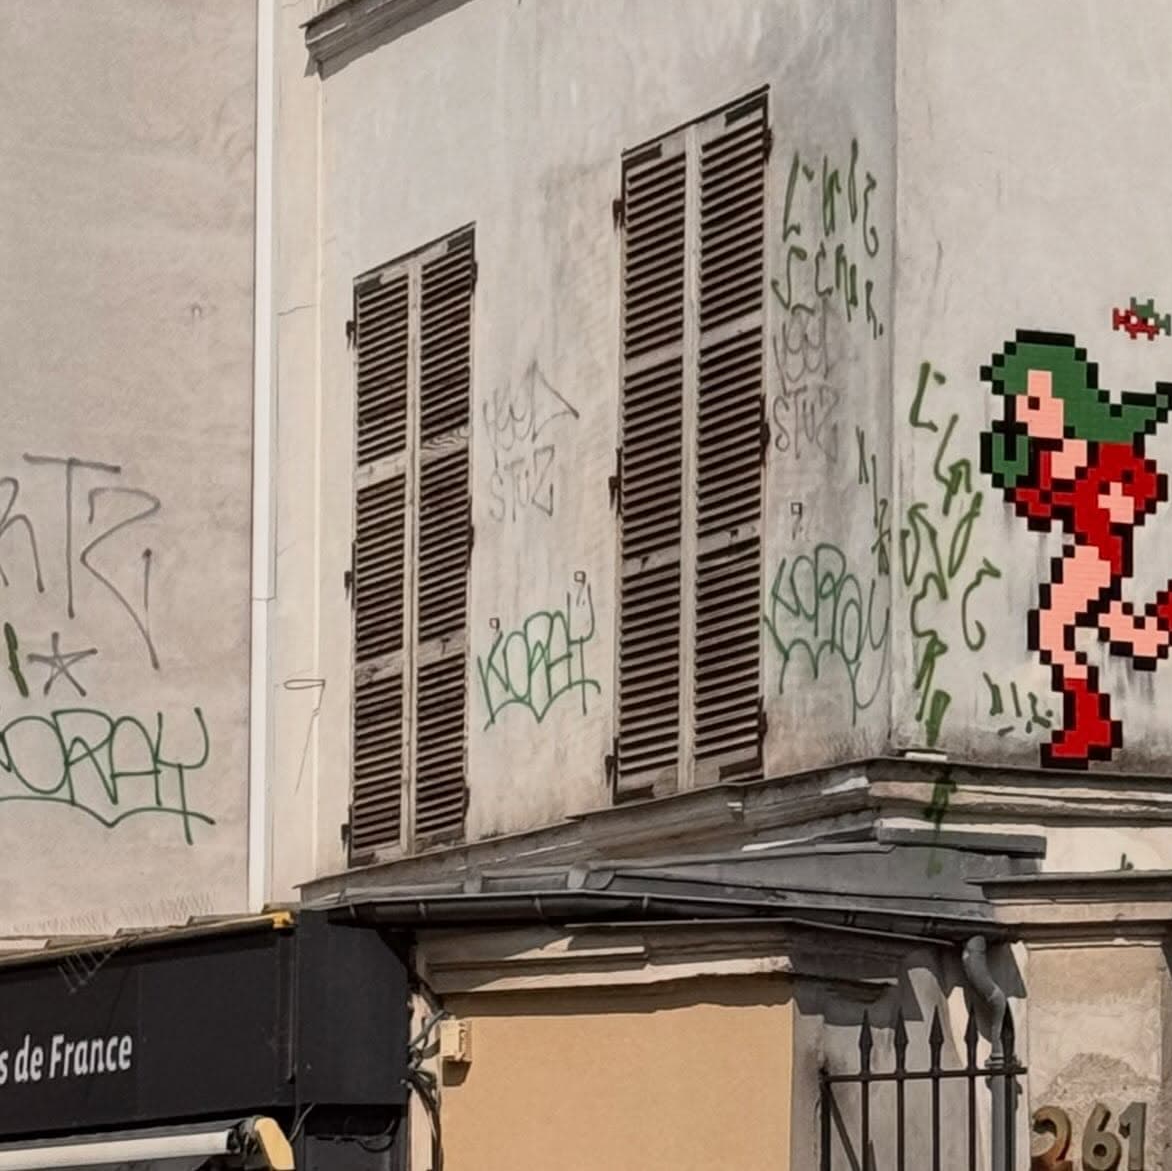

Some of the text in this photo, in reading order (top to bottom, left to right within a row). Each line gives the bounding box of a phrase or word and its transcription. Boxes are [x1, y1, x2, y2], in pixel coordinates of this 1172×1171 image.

[14, 1033, 44, 1083] de
[49, 1034, 133, 1080] France
[1030, 1100, 1148, 1171] 261
